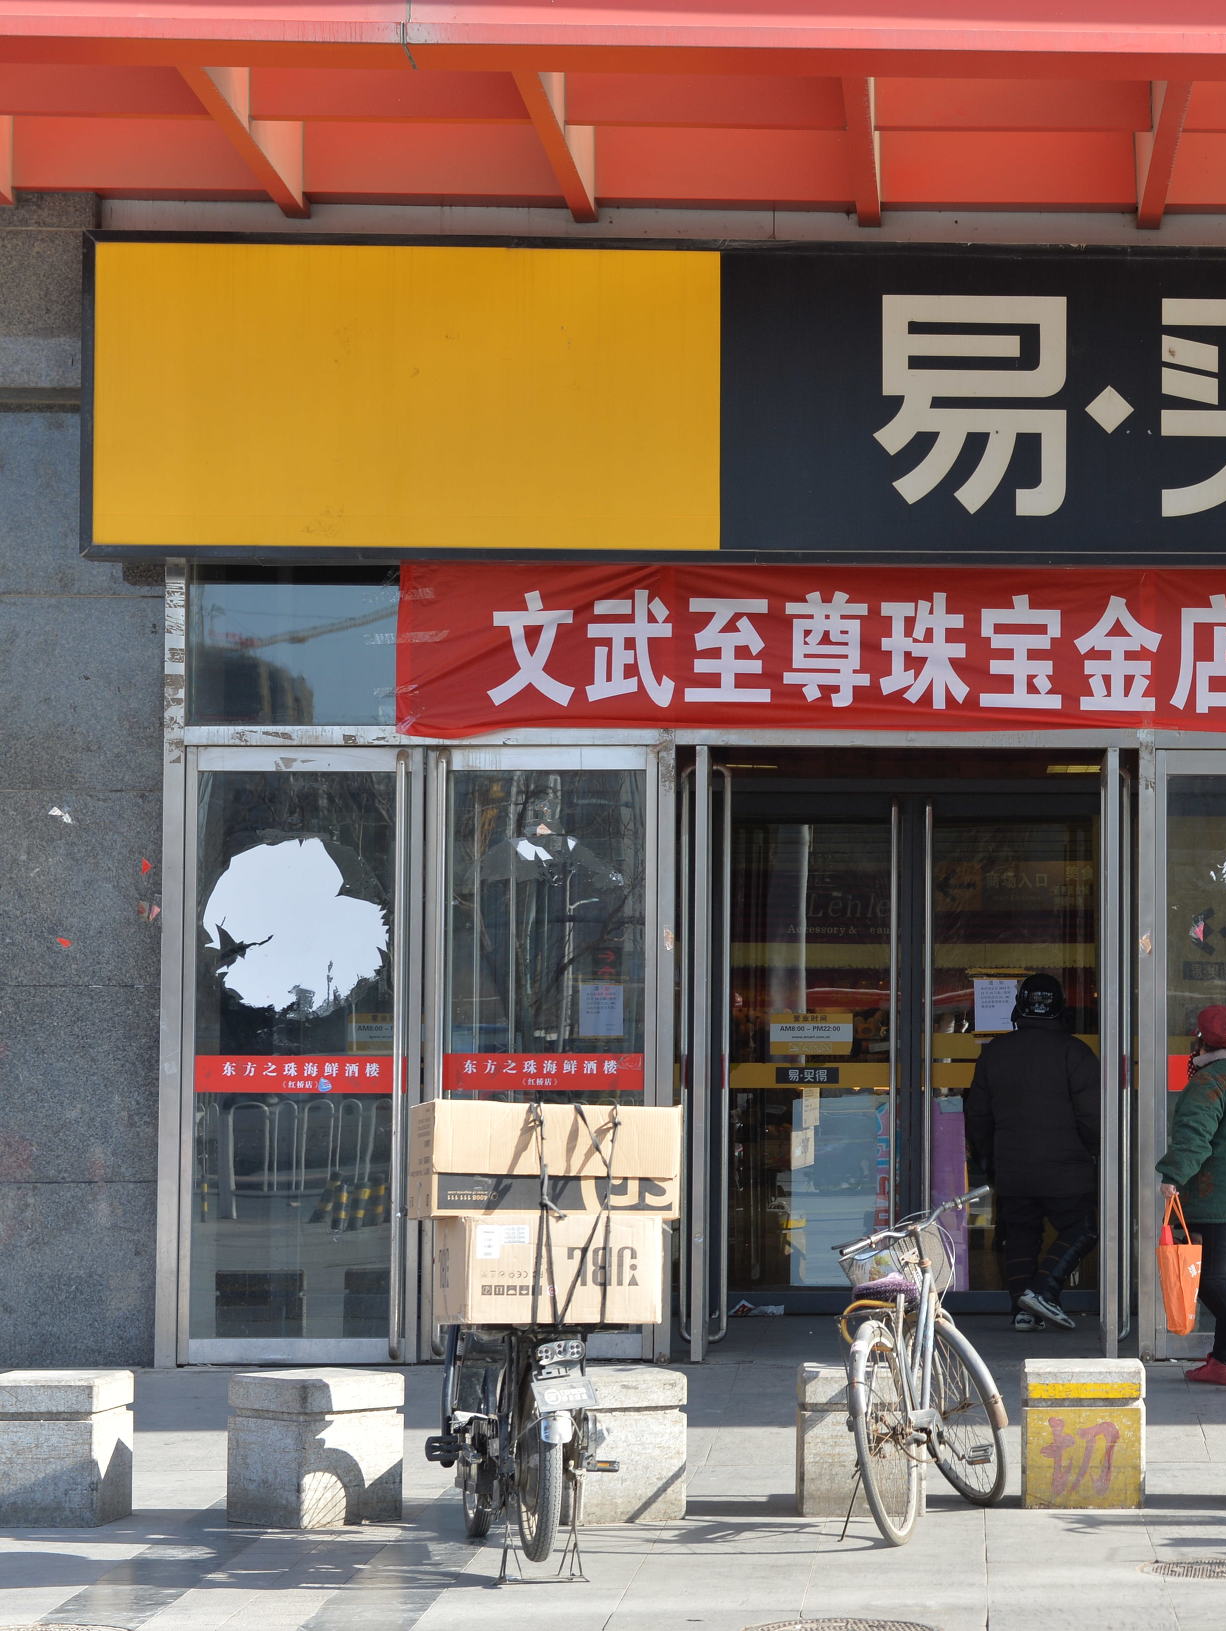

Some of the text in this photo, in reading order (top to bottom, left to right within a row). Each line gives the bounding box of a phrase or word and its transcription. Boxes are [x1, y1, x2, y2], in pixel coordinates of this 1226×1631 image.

[222, 1062, 380, 1078] 东方之珠海鲜酒楼
[463, 1059, 618, 1075] 东方之珠海鲜酒楼
[788, 1069, 828, 1082] 易·买得
[567, 1246, 639, 1287] JBL
